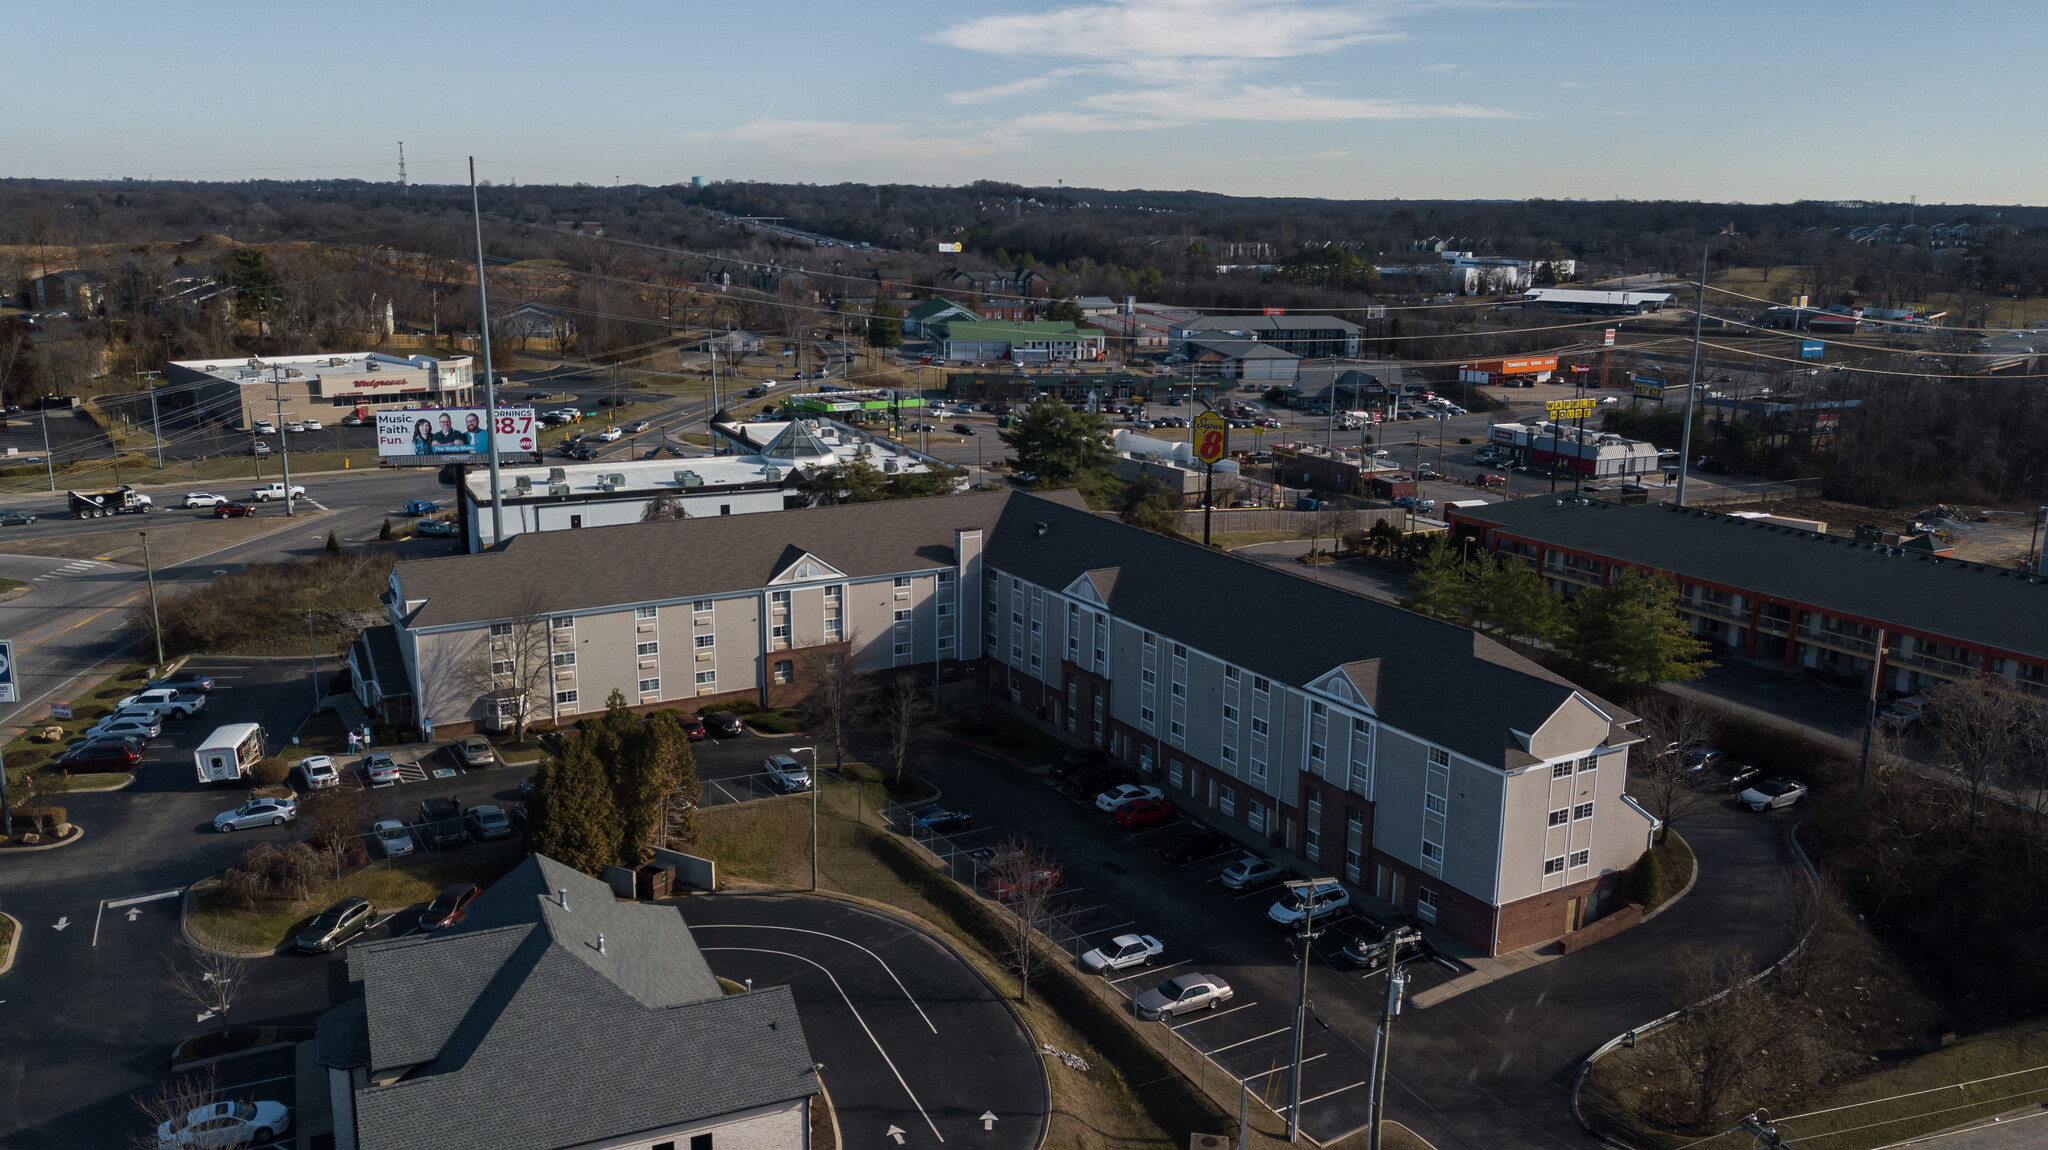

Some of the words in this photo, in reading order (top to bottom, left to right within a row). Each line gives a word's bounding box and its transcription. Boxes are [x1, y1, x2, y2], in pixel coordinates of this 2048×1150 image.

[353, 379, 408, 389] Walgreens
[1547, 400, 1595, 410] WAFFLE
[379, 414, 414, 423] Music.
[494, 410, 532, 418] ORNINGS
[1551, 409, 1590, 419] HOUSE
[379, 425, 411, 434] Faith.
[1197, 418, 1224, 434] Super
[380, 437, 404, 445] Fun.
[1200, 431, 1223, 459] 8
